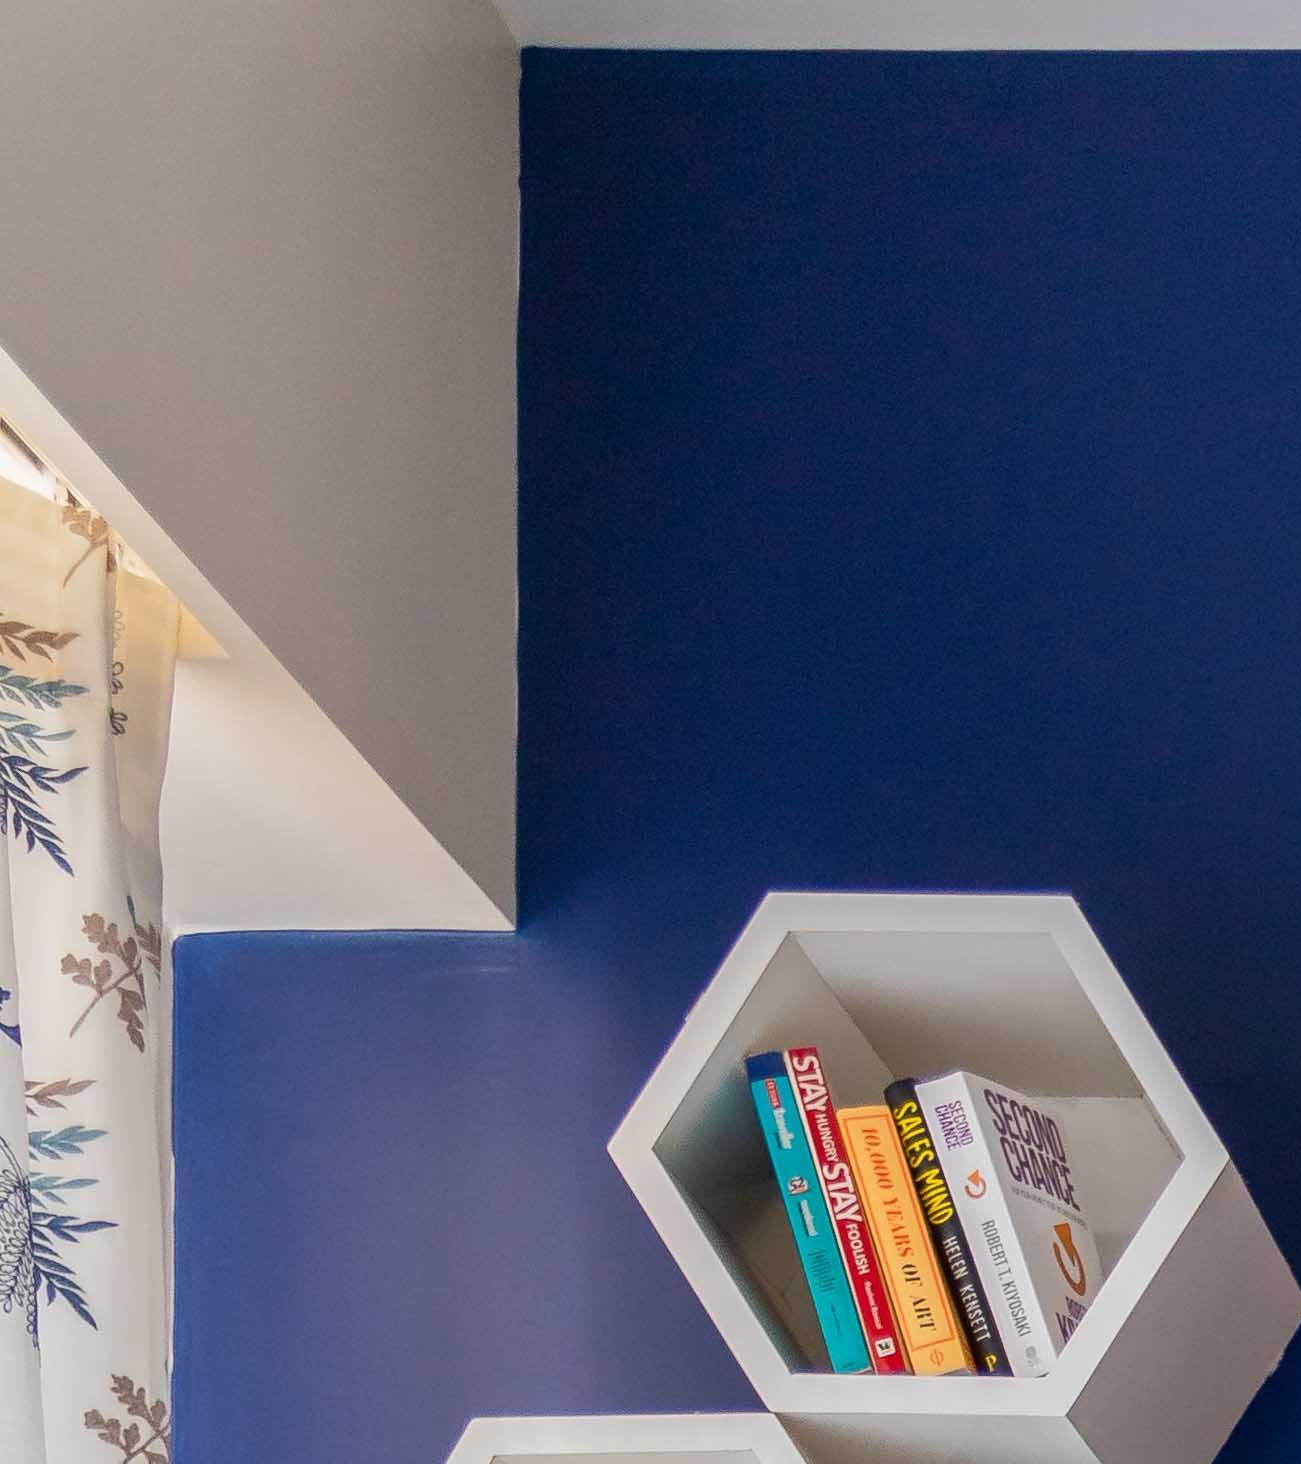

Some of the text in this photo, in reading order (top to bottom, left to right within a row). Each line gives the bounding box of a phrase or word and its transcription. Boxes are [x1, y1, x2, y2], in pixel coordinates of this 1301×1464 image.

[792, 1055, 829, 1112] STAY
[814, 1112, 839, 1162] HUNGRY
[935, 1104, 962, 1152] CHANCE
[948, 1100, 975, 1146] SECOND
[983, 1088, 1067, 1164] SECOND
[822, 1162, 863, 1222] STAY
[1000, 1136, 1081, 1212] CHANCE
[845, 1223, 870, 1275] FOOLISH
[861, 1127, 937, 1332] 10,000 YEARS OF ART
[894, 1100, 992, 1342] SALES MIND HELEN KENSETT
[981, 1219, 1008, 1263] ROBERT
[1002, 1279, 1033, 1337] KIYOSAKI
